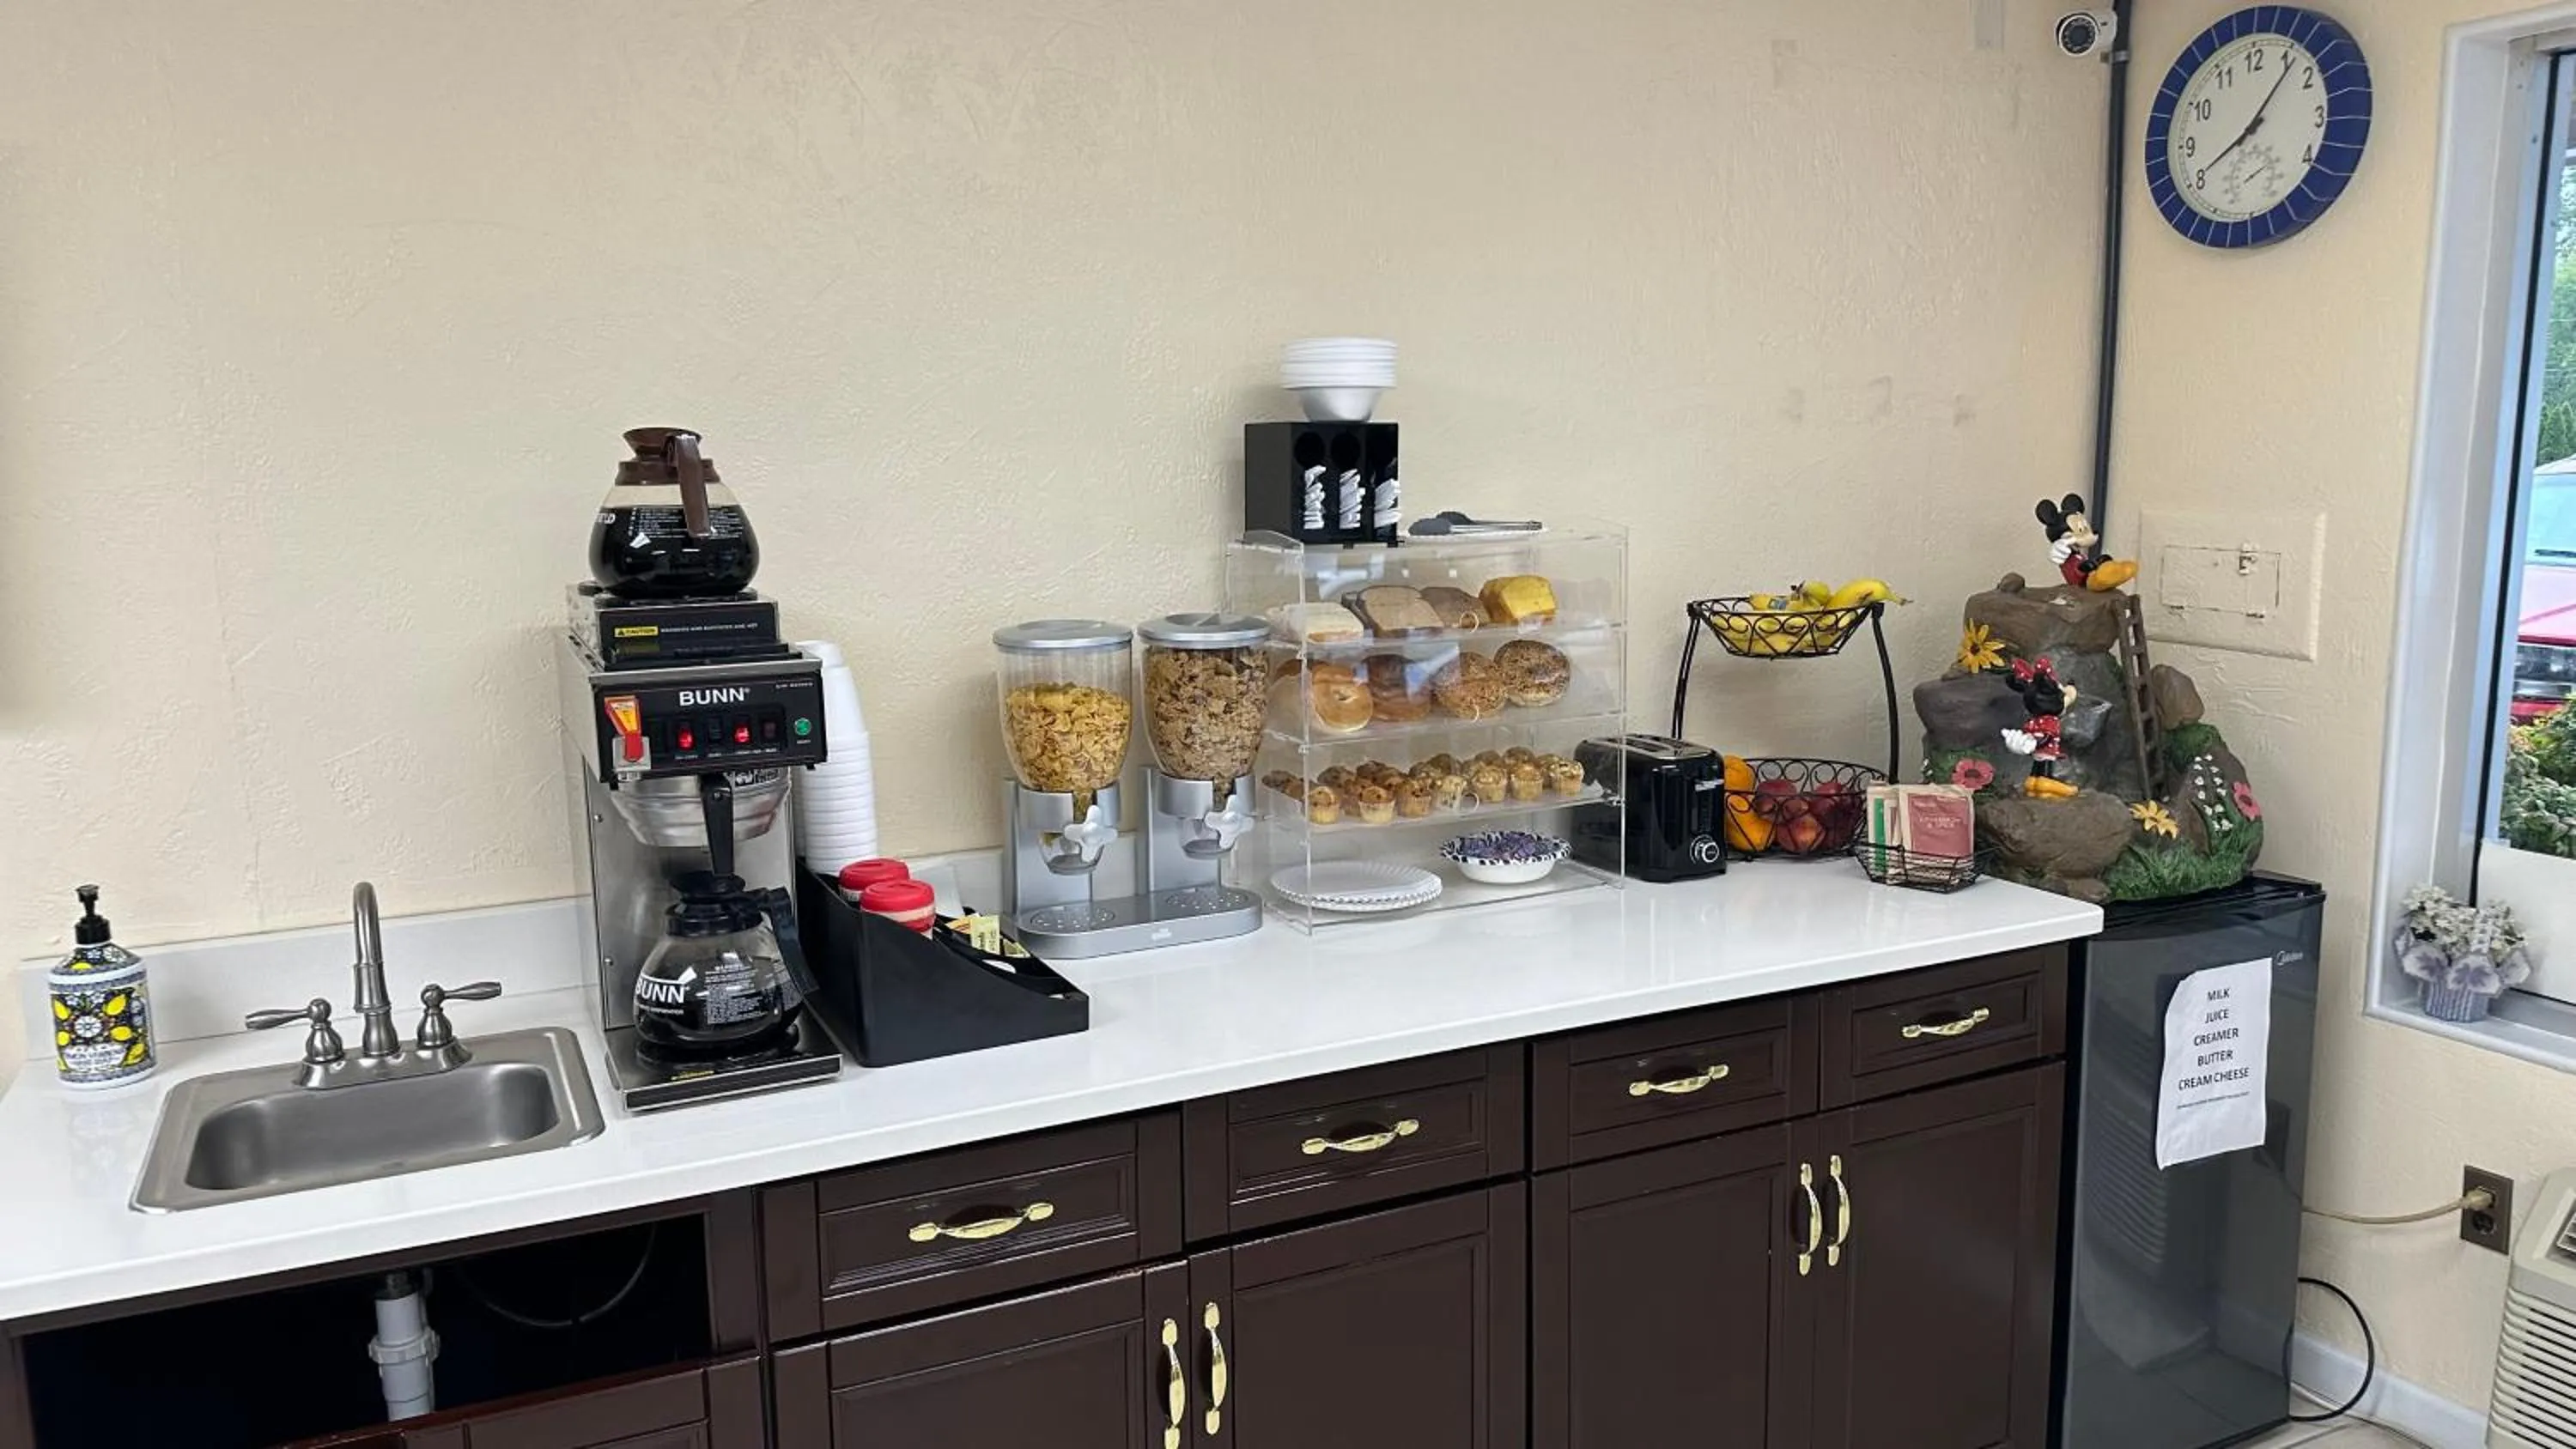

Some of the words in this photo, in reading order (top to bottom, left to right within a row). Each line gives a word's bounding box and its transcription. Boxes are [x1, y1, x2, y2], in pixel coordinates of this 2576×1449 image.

[2245, 49, 2263, 73] 12
[2215, 68, 2233, 89] 11
[2302, 67, 2313, 89] 2
[2194, 99, 2211, 122] 10
[2314, 106, 2324, 129] 3
[2185, 136, 2196, 158] 9
[2301, 144, 2312, 165] 4
[2196, 169, 2206, 191] 8
[679, 688, 744, 706] BUNN
[635, 979, 685, 1003] BUNN
[2208, 988, 2230, 1001] MILK
[2205, 1009, 2229, 1024] JUICE
[2194, 1028, 2239, 1046] CREAMER
[2197, 1050, 2233, 1066] BUTTER
[2178, 1074, 2213, 1090] CREAM
[2214, 1067, 2250, 1082] CHEESE
